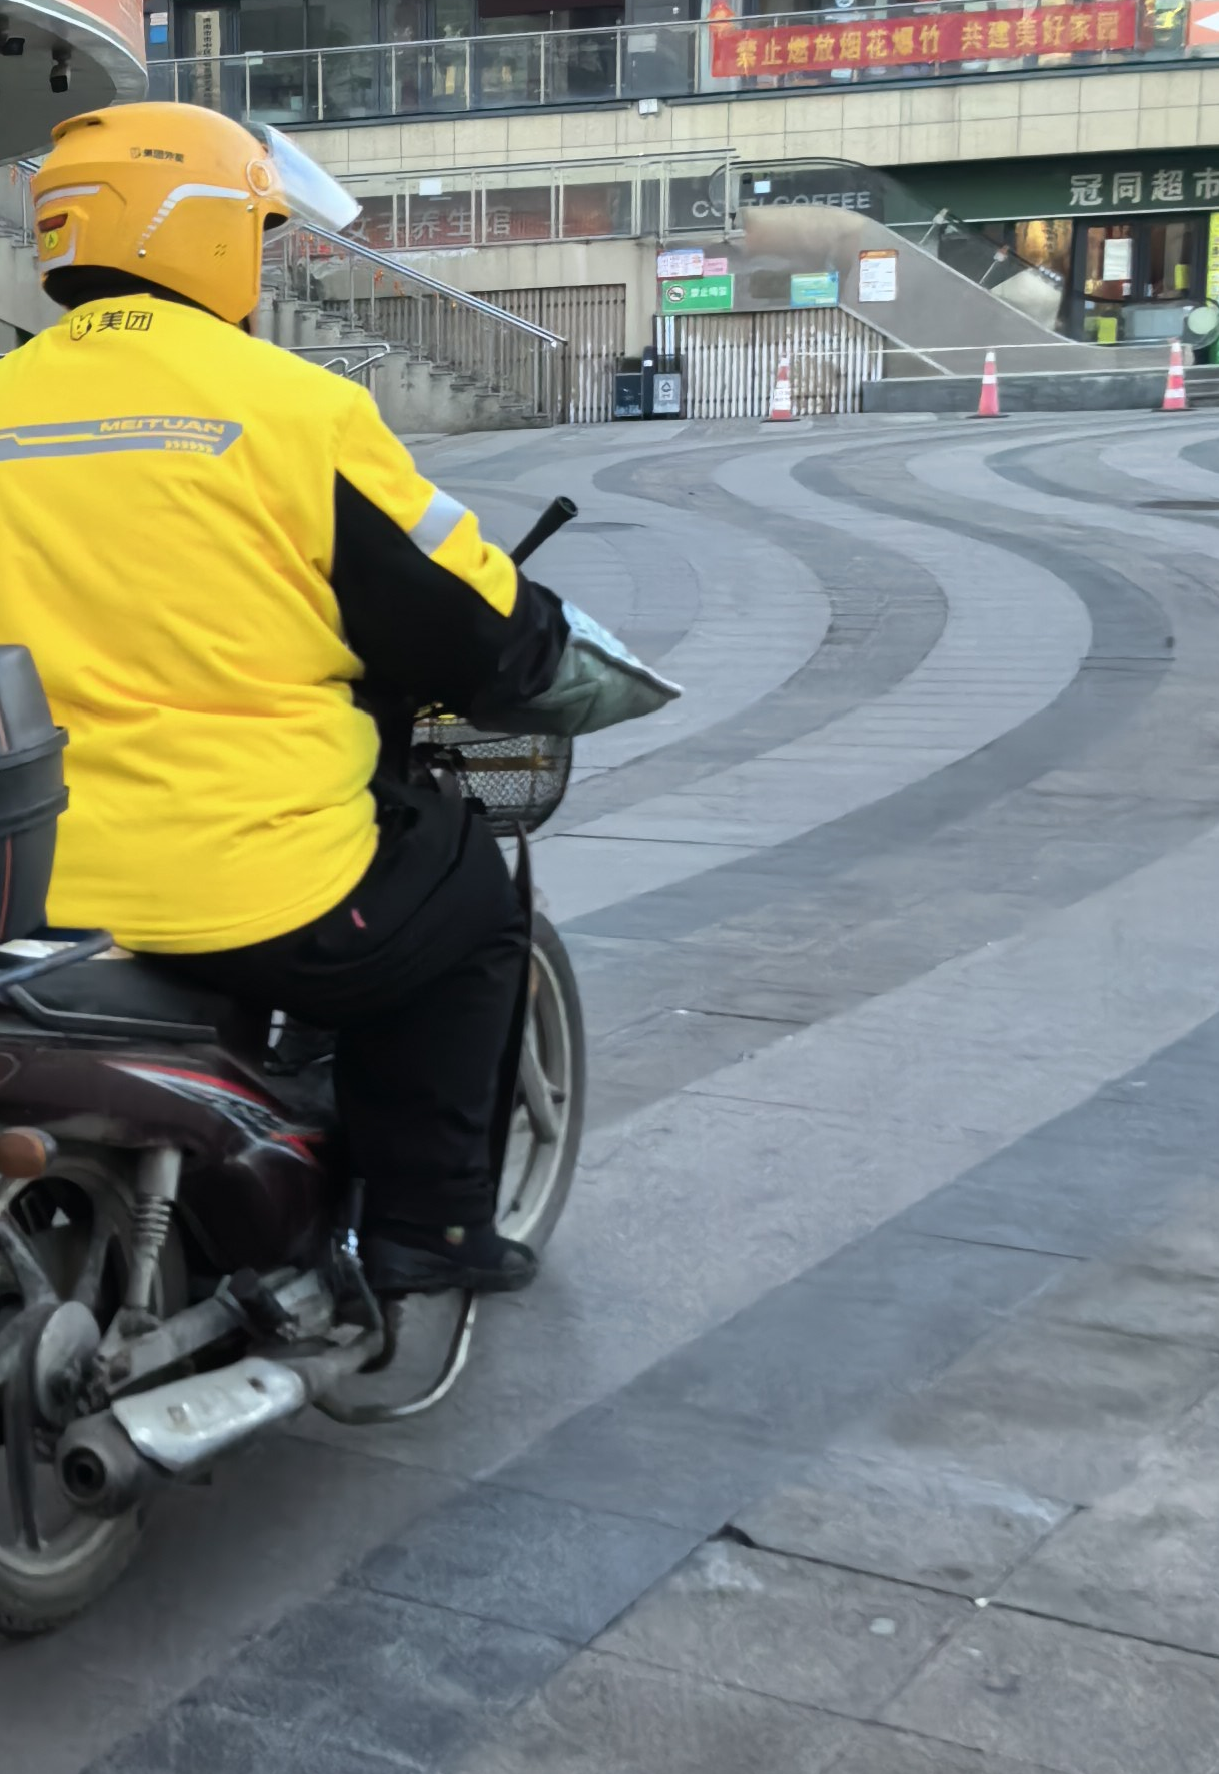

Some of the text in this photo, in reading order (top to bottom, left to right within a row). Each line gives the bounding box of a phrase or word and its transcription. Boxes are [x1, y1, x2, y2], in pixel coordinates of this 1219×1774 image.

[736, 11, 1120, 74] 禁止燃放烟花爆竹 共建美好家园
[1069, 167, 1219, 206] 冠同超市
[96, 310, 153, 332] 美团
[99, 418, 225, 434] MEITUAN
